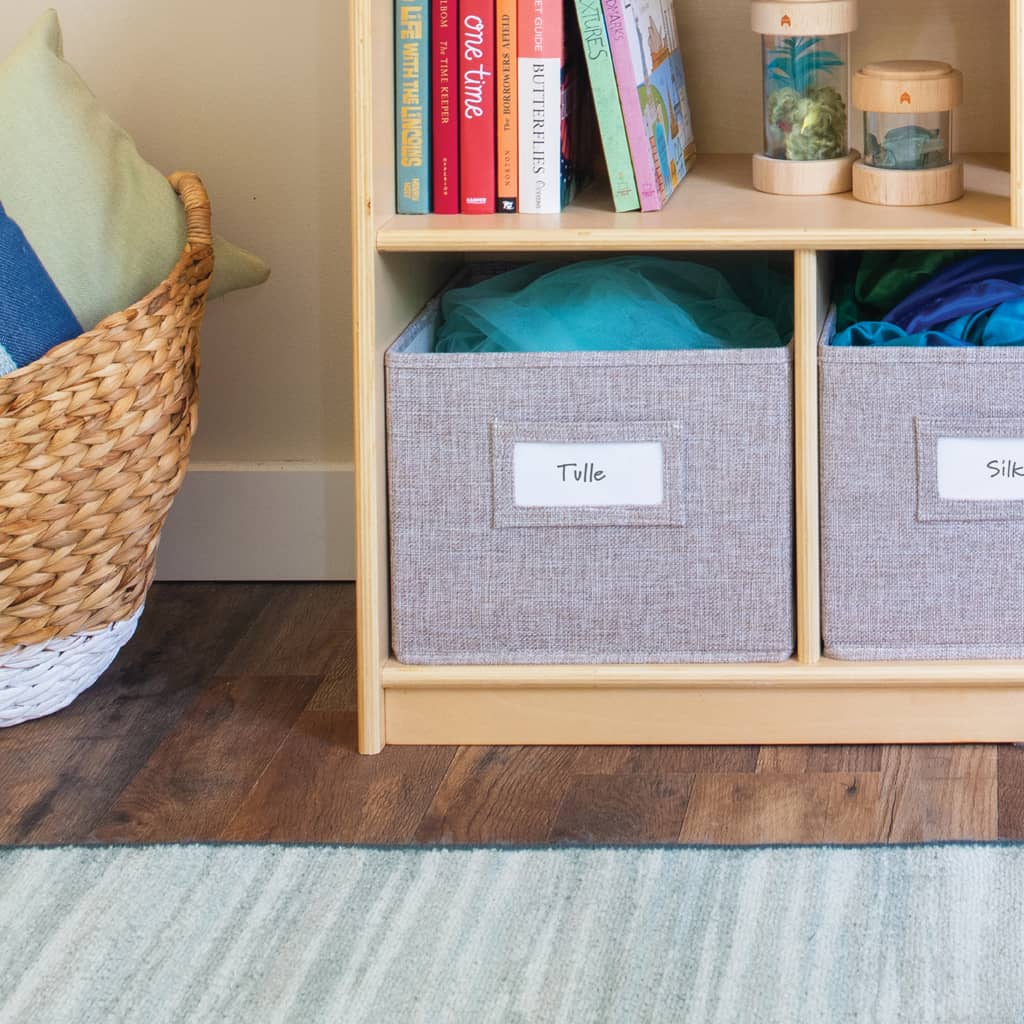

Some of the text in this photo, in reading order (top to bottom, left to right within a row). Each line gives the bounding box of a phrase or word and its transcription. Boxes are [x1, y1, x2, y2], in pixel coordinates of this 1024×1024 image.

[501, 14, 511, 49] AFIELD
[534, 16, 544, 53] GUIDE
[440, 41, 449, 124] The TIME KEEPER
[463, 15, 492, 120] one time
[502, 52, 511, 115] BORROWERS
[402, 81, 420, 105] THE
[532, 63, 545, 175] BUTTERFLIES
[556, 462, 607, 483] Tulle
